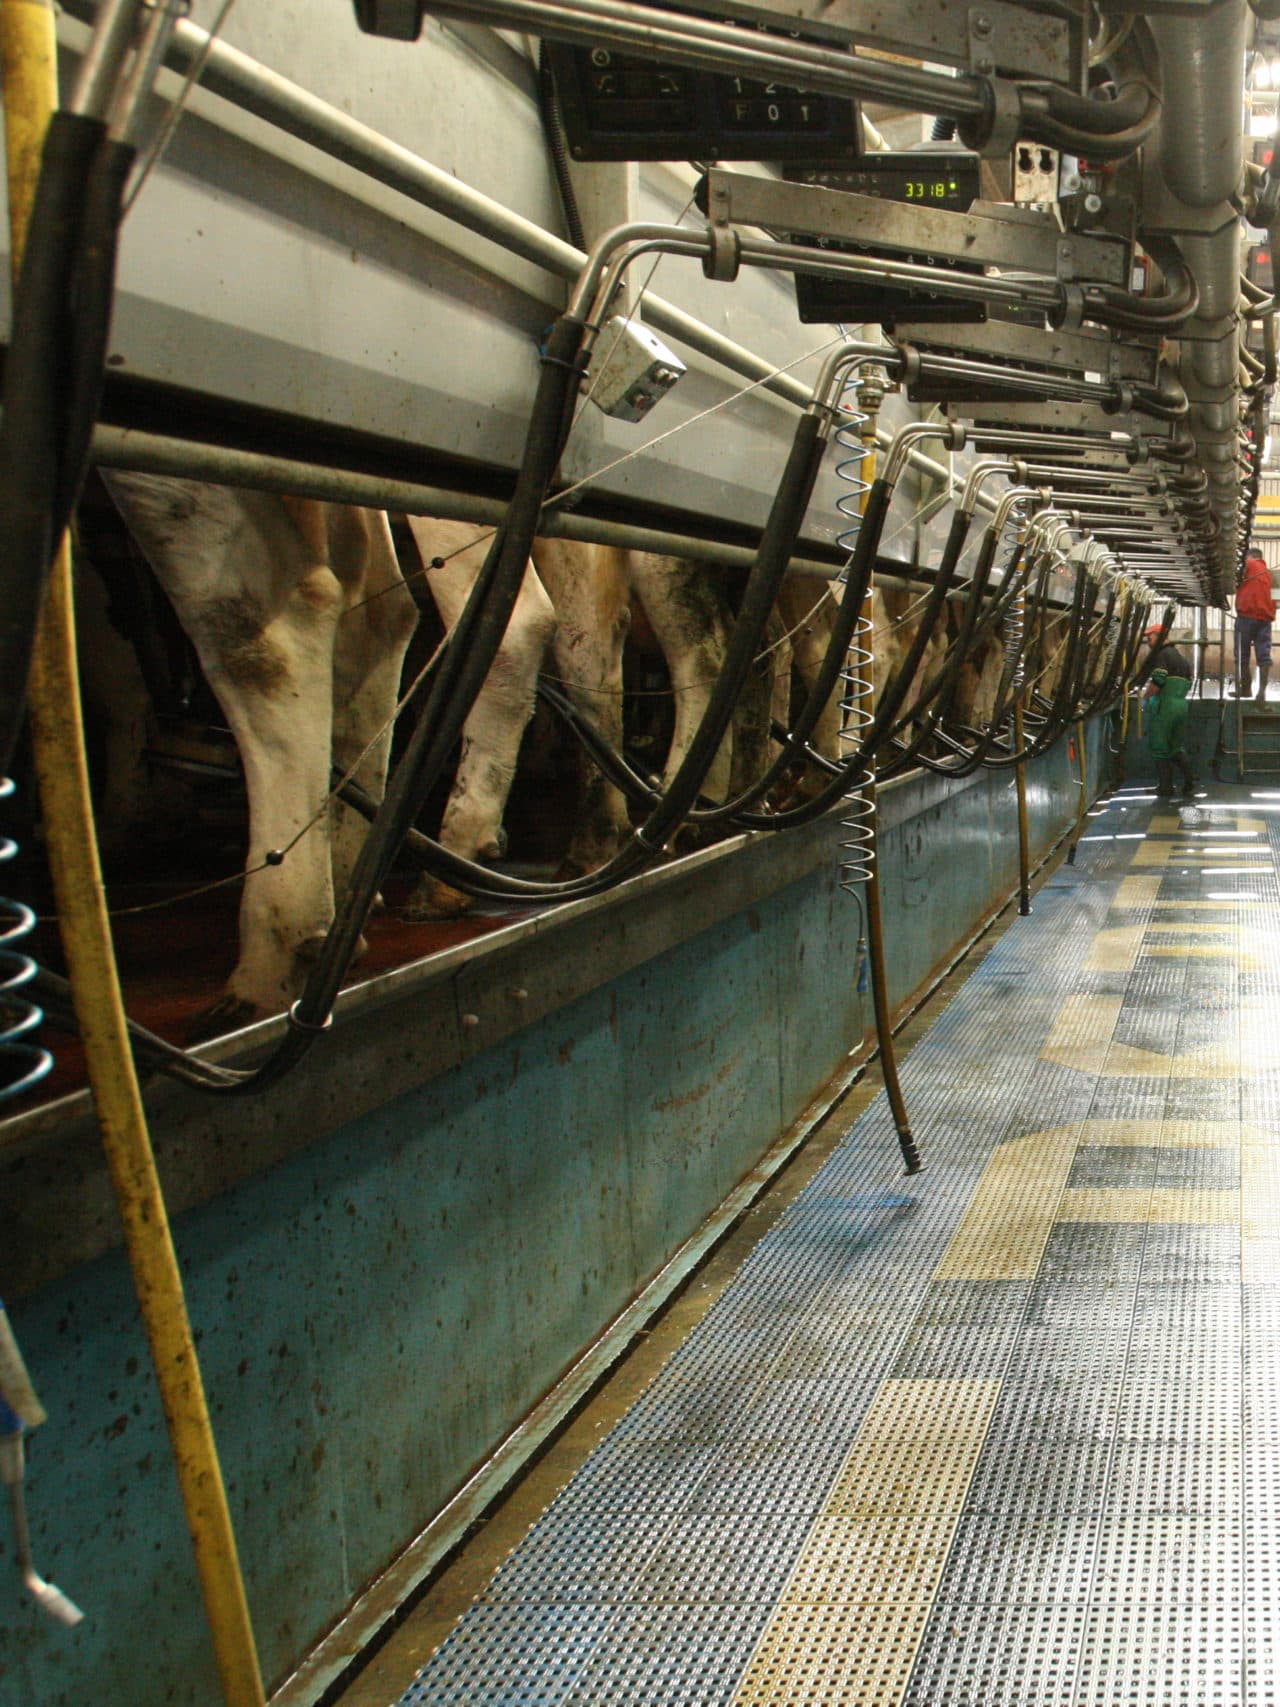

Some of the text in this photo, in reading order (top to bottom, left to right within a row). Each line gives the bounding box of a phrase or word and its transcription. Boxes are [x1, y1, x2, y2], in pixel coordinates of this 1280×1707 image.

[734, 78, 742, 93] 1
[801, 105, 808, 121] 1
[905, 182, 946, 198] 3318
